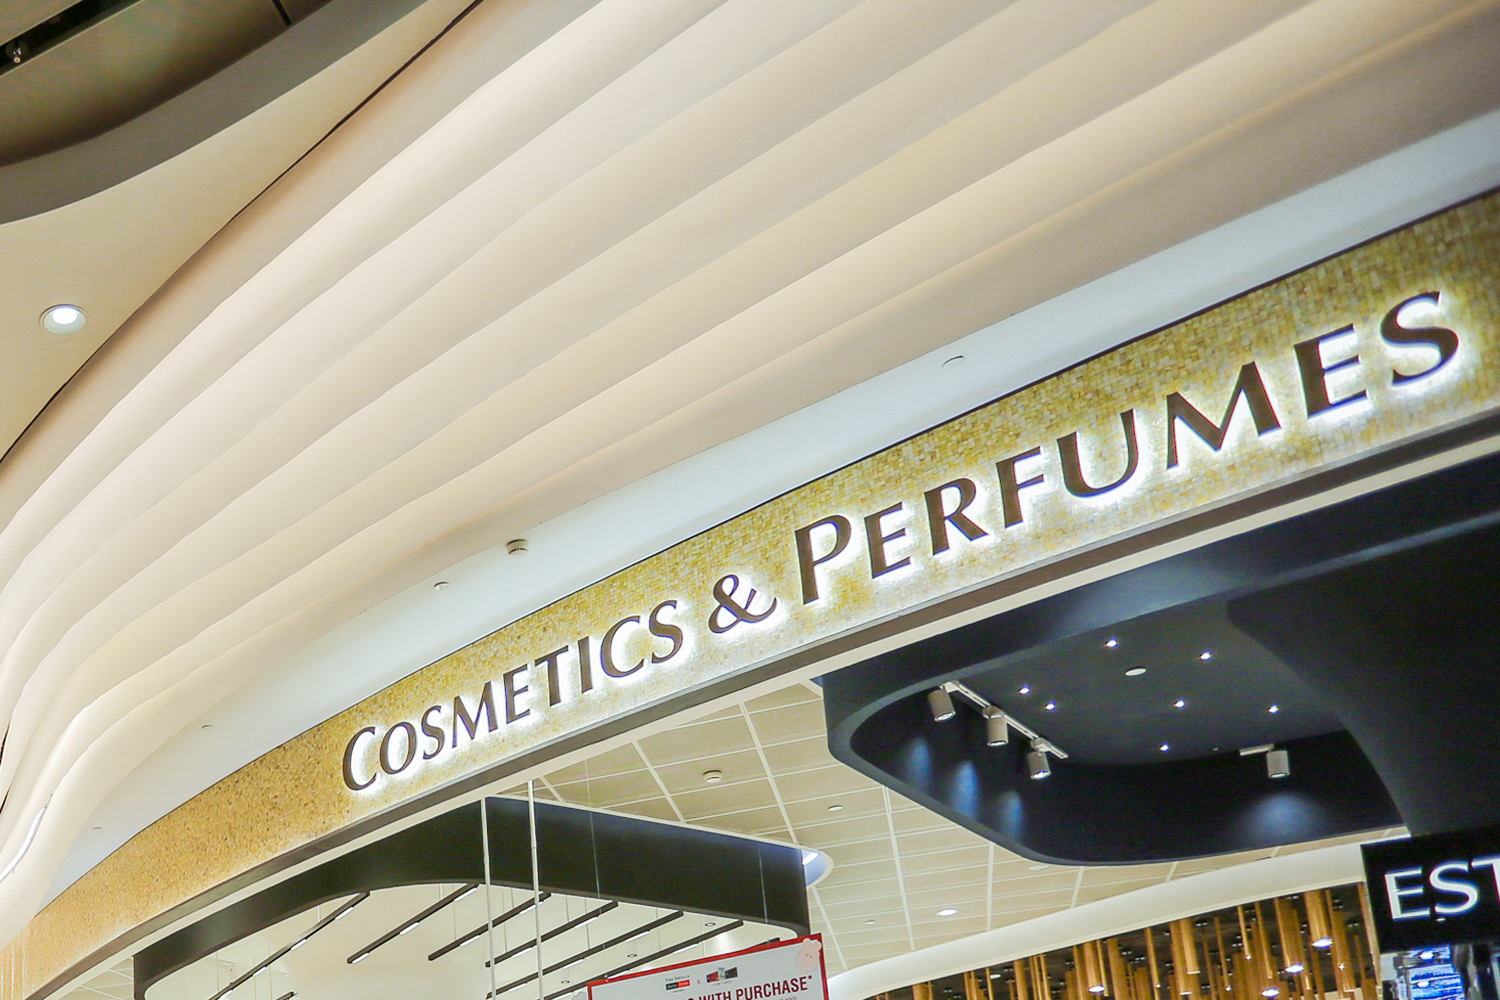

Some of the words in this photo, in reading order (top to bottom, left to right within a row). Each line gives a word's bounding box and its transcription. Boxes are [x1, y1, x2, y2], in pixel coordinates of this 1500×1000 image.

[342, 601, 686, 792] COSMETICS
[708, 573, 778, 636] &
[795, 290, 1461, 604] PERFUMES
